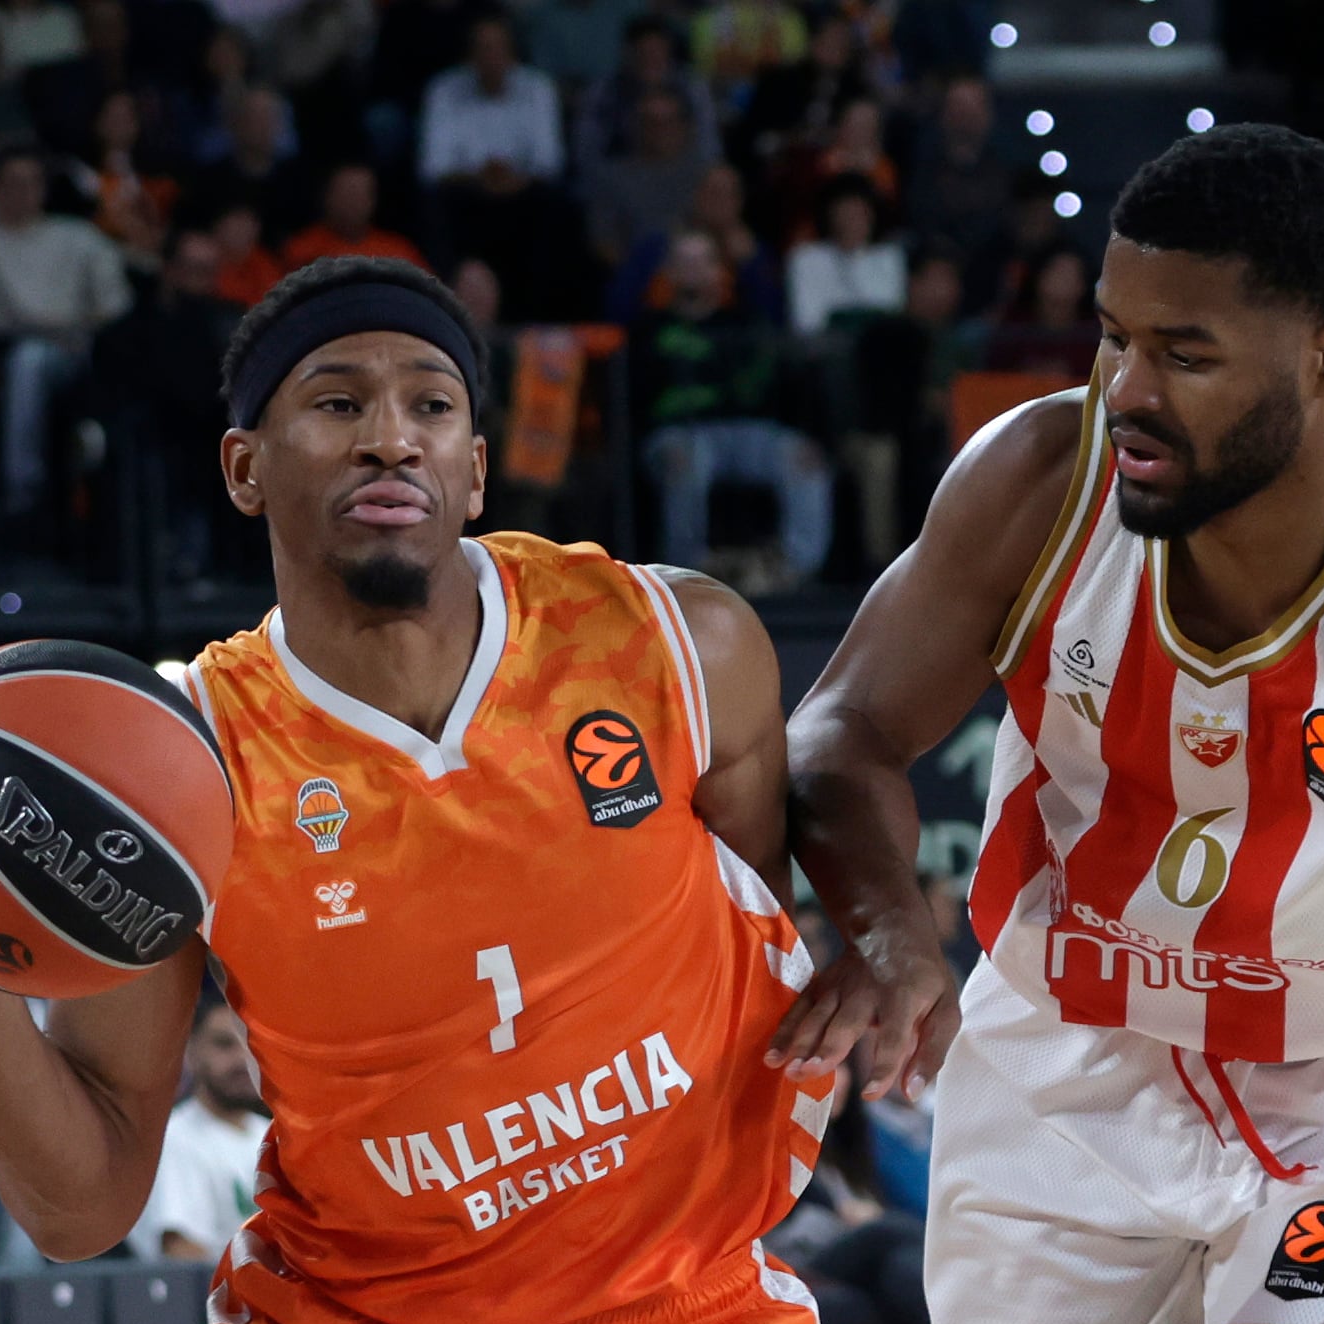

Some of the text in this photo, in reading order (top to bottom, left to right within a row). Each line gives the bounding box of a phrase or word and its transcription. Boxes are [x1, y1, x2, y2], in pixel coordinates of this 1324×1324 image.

[594, 791, 659, 822] abu dhabi
[1156, 806, 1237, 909] 6
[316, 908, 367, 930] hummel
[1048, 930, 1289, 992] mts
[476, 944, 524, 1054] 1
[361, 1031, 693, 1197] VALENCIA
[463, 1133, 629, 1231] BASKET
